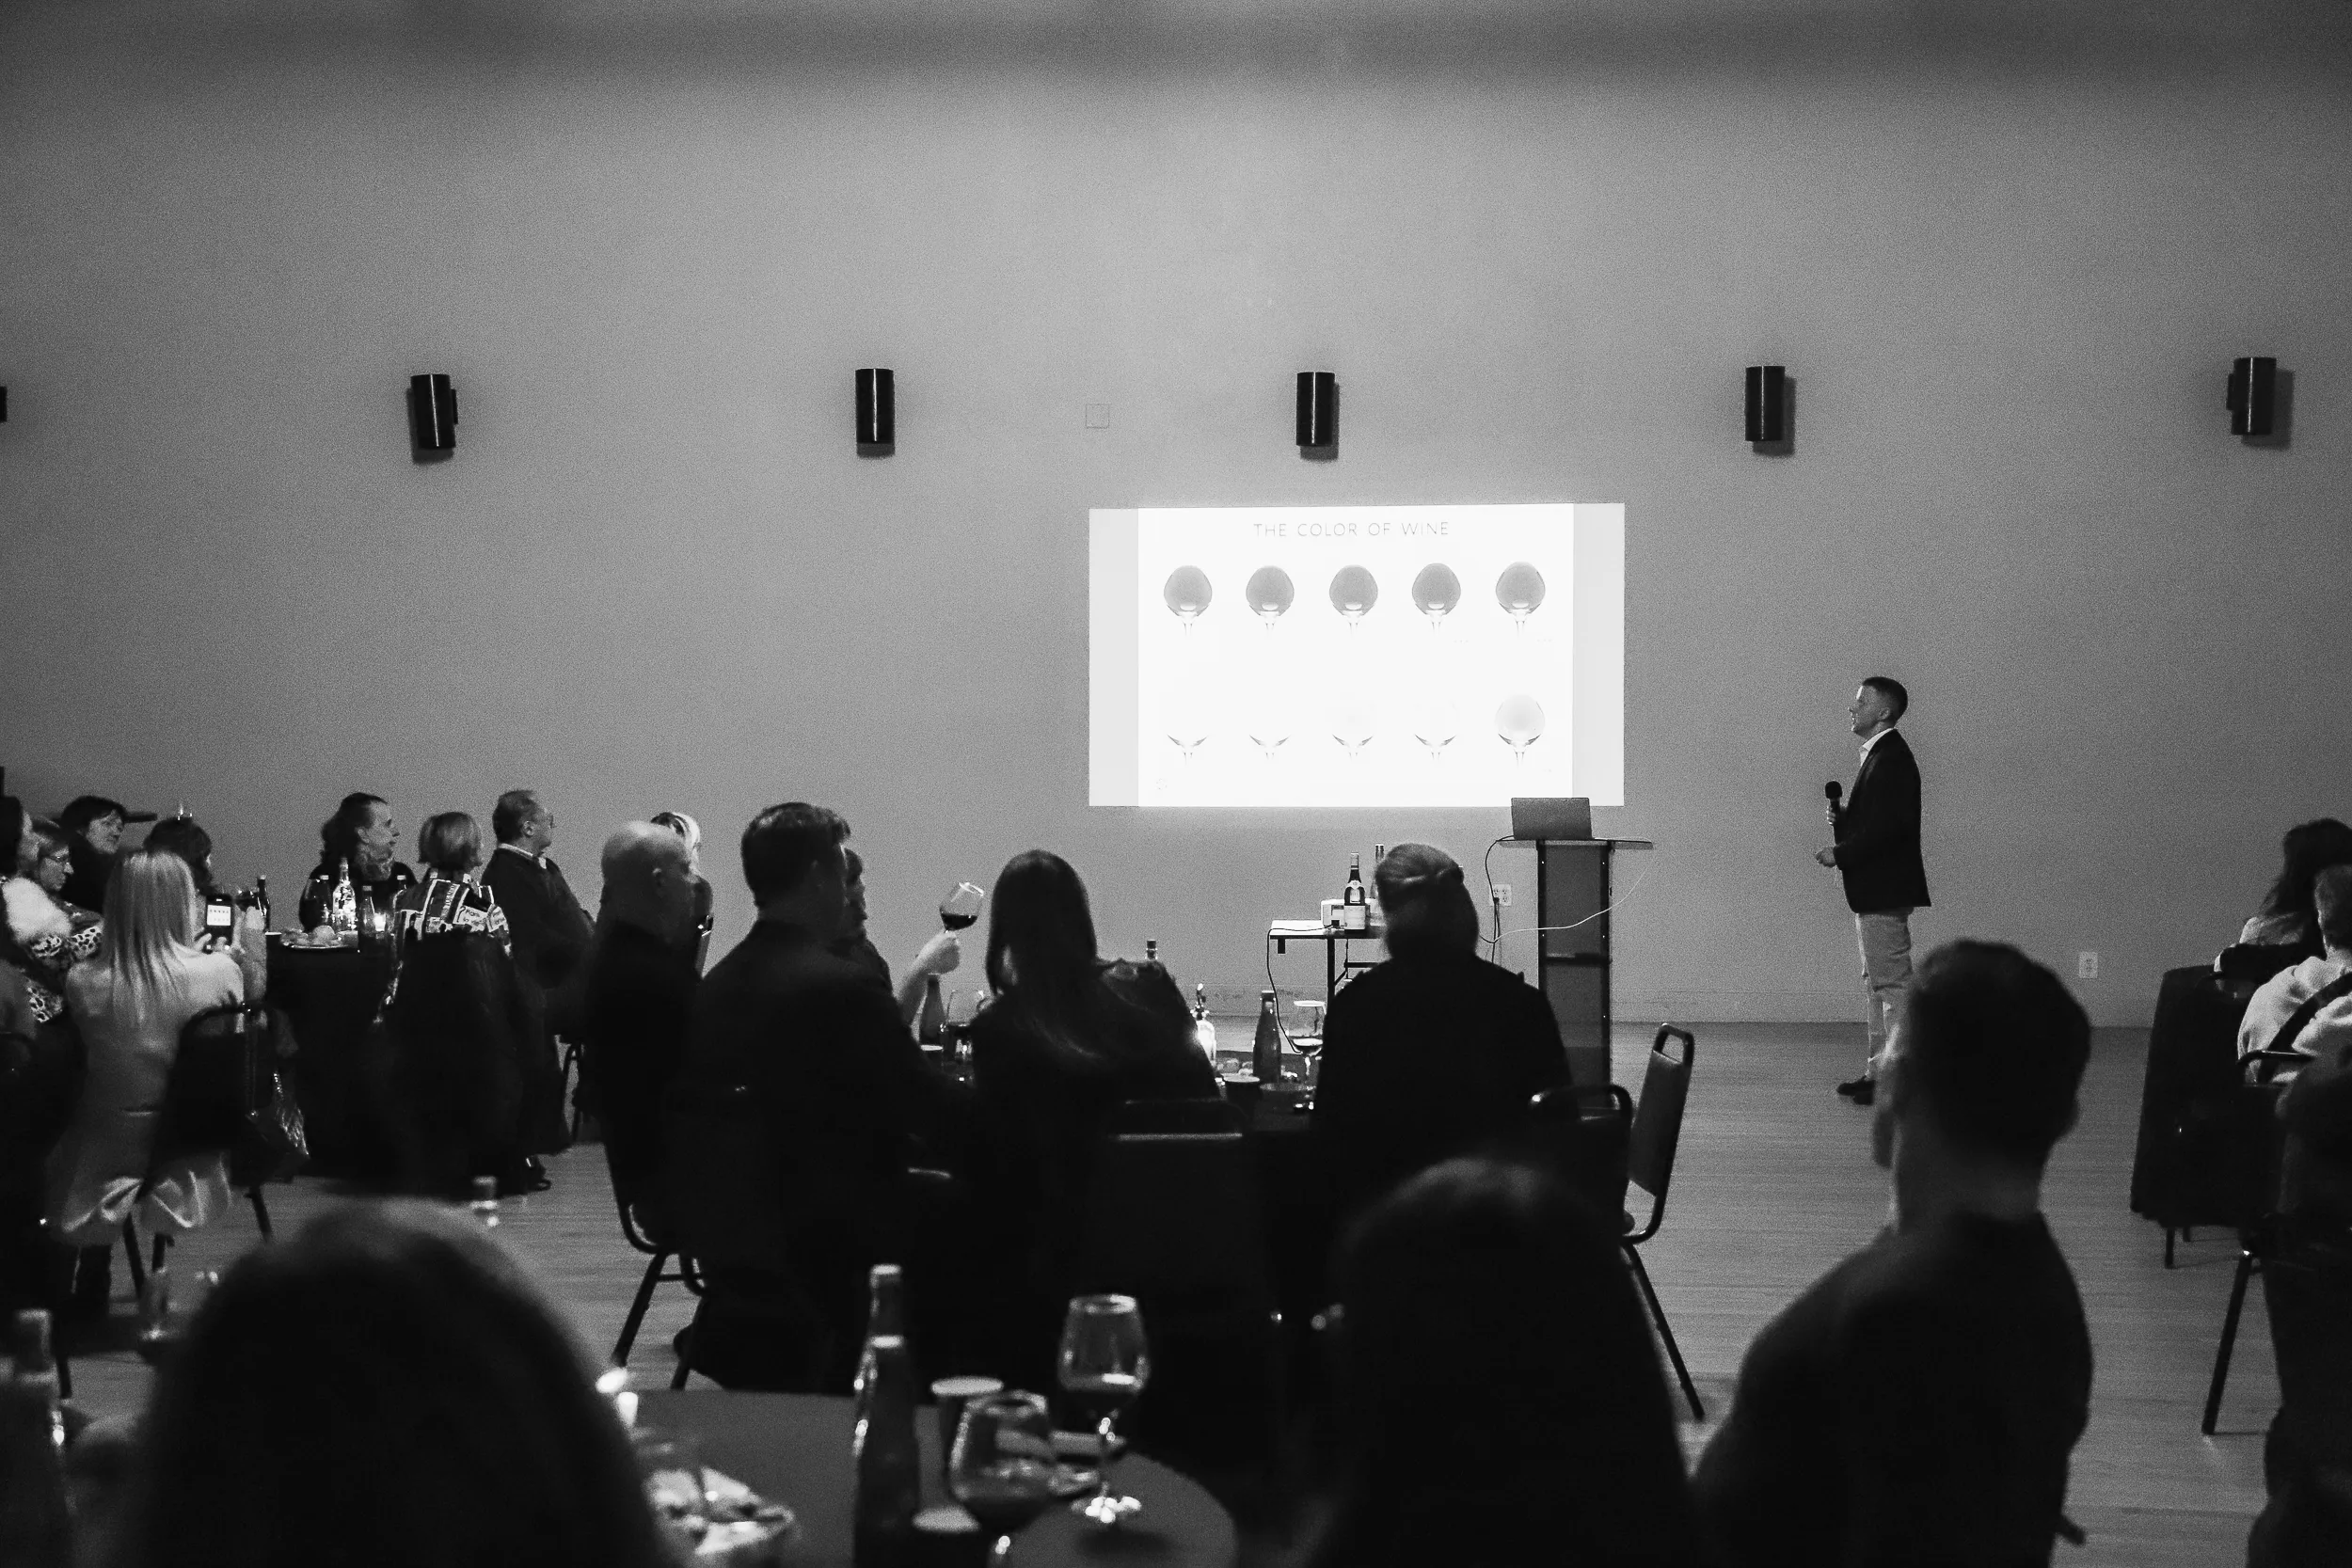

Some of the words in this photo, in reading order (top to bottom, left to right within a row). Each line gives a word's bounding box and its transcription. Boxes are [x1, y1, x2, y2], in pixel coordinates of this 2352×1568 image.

[1253, 523, 1287, 537] THE
[1297, 522, 1358, 537] COLOR
[1368, 522, 1391, 536] OF
[1401, 521, 1449, 535] WINE
